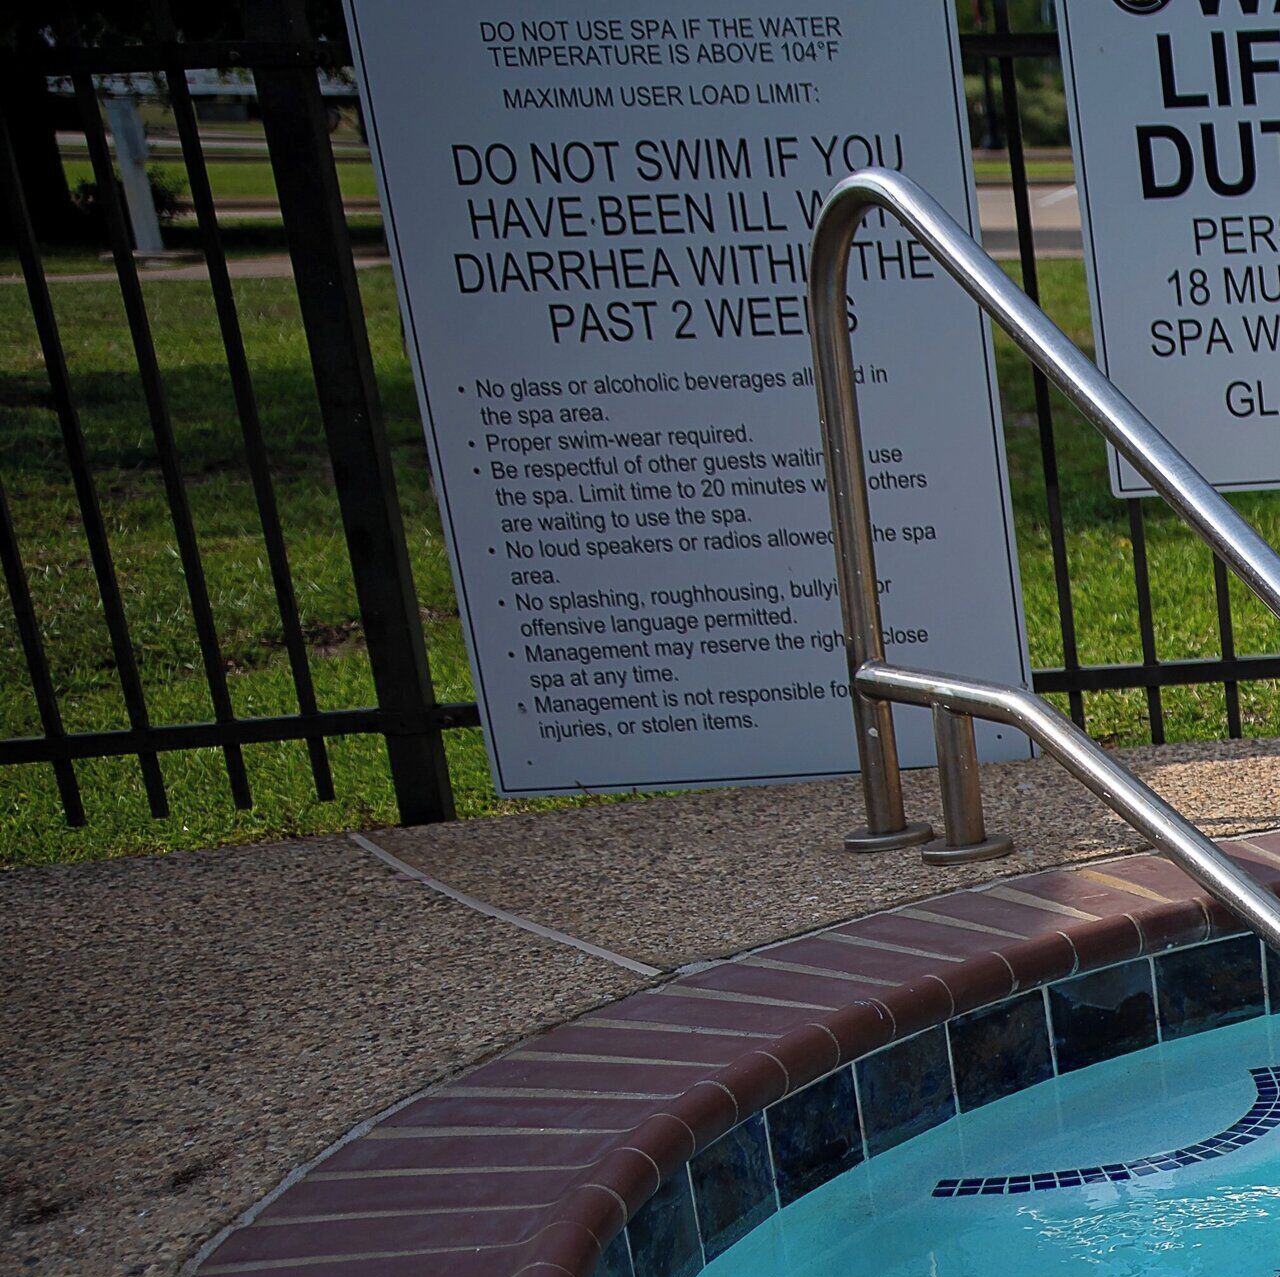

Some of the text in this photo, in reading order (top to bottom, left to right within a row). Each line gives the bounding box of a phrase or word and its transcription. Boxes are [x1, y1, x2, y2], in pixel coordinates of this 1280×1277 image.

[479, 16, 842, 42] DO NOT USE SPA IF THE WATER
[487, 44, 662, 67] TEMPERATURE
[668, 43, 690, 64] IS
[696, 42, 774, 64] ABOVE
[502, 82, 819, 109] MAXIMUM USER LOAD LIMIT:
[451, 134, 903, 185] DO NOT SWIM IF YOU
[467, 196, 587, 239] HAVE
[597, 192, 715, 236] BEEN
[727, 191, 788, 232] ILL
[453, 239, 934, 294] DIARRHEA WITHI THE
[1167, 268, 1210, 306] 18
[548, 300, 657, 343] PAST
[671, 299, 697, 339] 2
[1150, 317, 1234, 357] SPA
[480, 406, 609, 428] the spa area.
[485, 423, 753, 456] Proper swim-wear required.
[520, 606, 797, 637] offensive language permitted.
[529, 665, 679, 691] spa at any time.
[538, 712, 758, 742] injuries, or stolen items.
